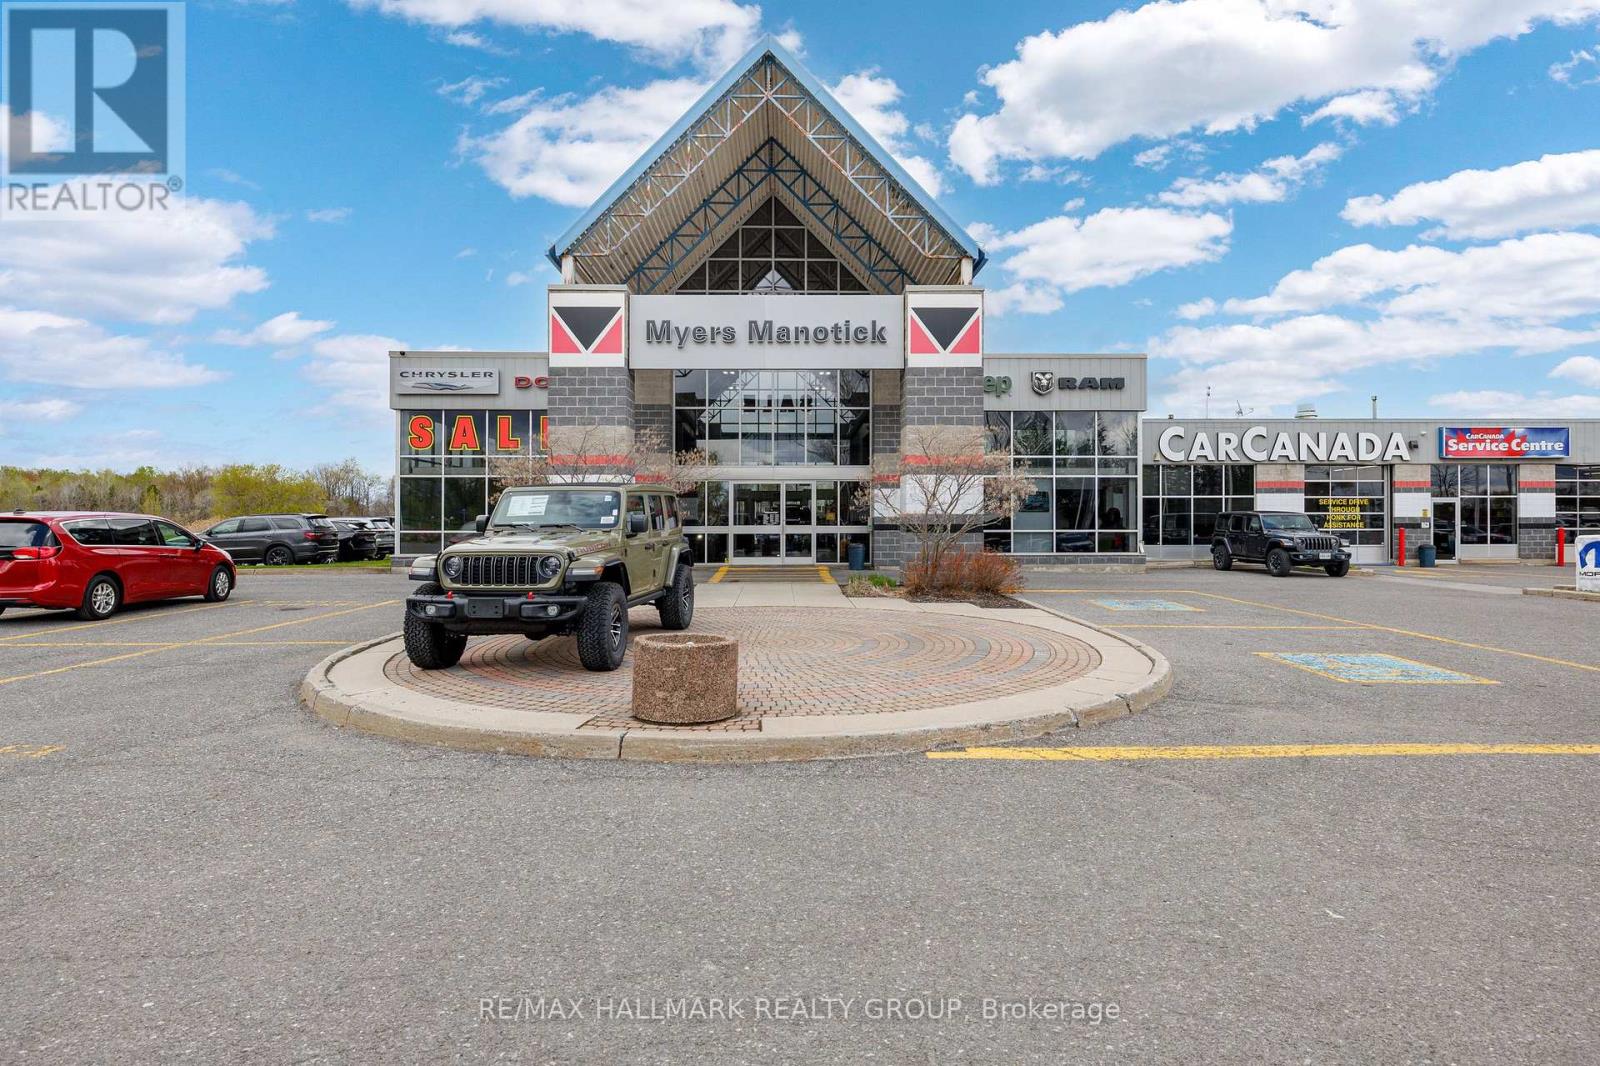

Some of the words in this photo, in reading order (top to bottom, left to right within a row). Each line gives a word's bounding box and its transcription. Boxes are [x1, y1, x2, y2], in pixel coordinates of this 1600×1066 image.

[645, 319, 737, 349] Myers
[748, 319, 888, 344] Manotick
[1058, 377, 1125, 391] RAM
[1158, 426, 1411, 462] CARCANADA
[1448, 438, 1509, 451] Service
[1511, 438, 1564, 451] Centre
